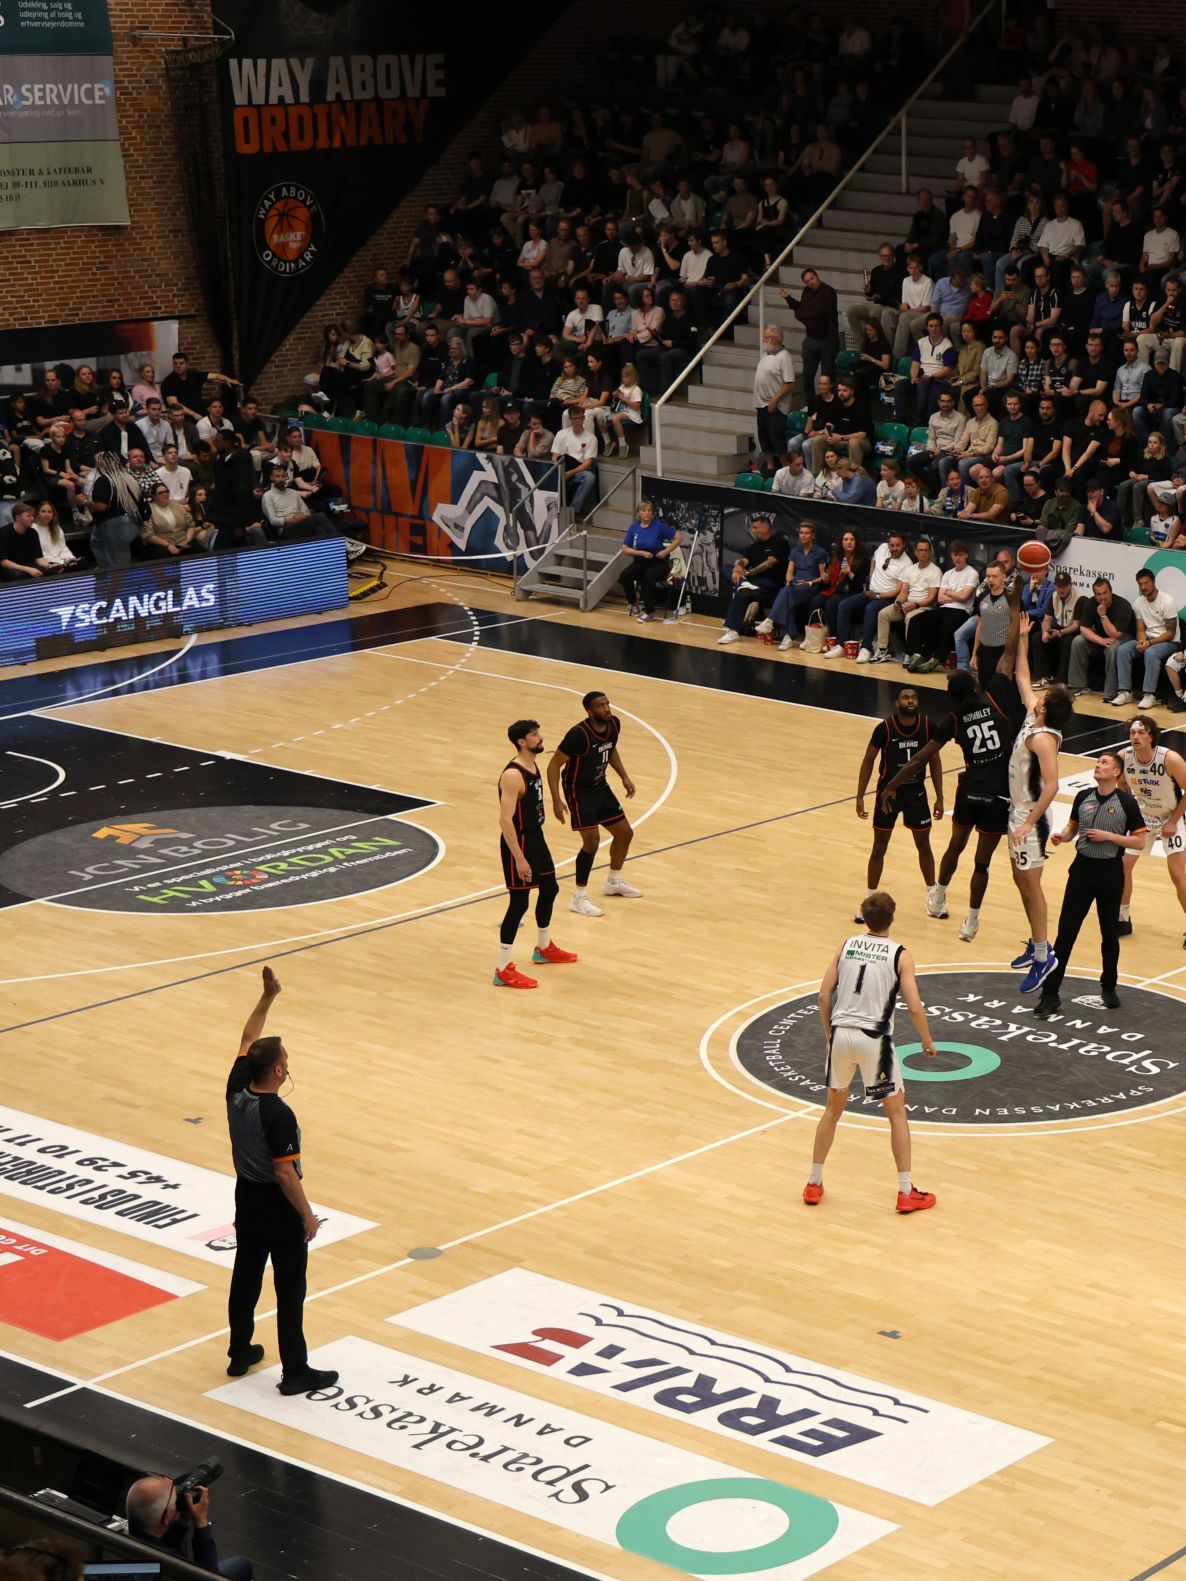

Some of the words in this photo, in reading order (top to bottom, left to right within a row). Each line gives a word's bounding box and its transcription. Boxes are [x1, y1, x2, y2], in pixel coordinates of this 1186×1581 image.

[20, 11, 48, 20] udlejning
[229, 58, 315, 105] WAY
[326, 54, 446, 101] ABOVE
[21, 83, 106, 106] SERVICE
[233, 98, 431, 154] ORDINARY
[258, 191, 276, 219] WAY
[263, 243, 318, 272] ORDINARY
[1049, 560, 1115, 581] Sparekassen
[75, 584, 216, 628] SCANGLAS
[966, 720, 1001, 754] 25
[1137, 778, 1160, 787] STARK
[1150, 762, 1165, 777] 40
[157, 819, 311, 858] BOLIG
[1167, 835, 1182, 849] 40
[67, 854, 166, 881] JCN
[136, 836, 403, 905] HVORDAN
[1014, 851, 1028, 866] 35
[849, 939, 890, 954] INVITA
[854, 950, 889, 962] MISTER
[853, 963, 867, 996] 1
[768, 1004, 821, 1037] CENTER
[894, 995, 1180, 1076] Sparekass
[763, 1039, 827, 1092] BASKETBALL
[974, 1085, 1154, 1116] SPAREKASSEN
[2, 1133, 45, 1147] 11
[36, 1144, 82, 1159] 10
[75, 1156, 128, 1172] 29
[115, 1169, 182, 1190] +45
[79, 1188, 142, 1211] OS
[115, 1200, 200, 1230] FIND
[14, 1243, 48, 1256] DIT
[388, 1373, 593, 1448] DANMARK
[566, 1343, 885, 1458] ERRIA
[305, 1385, 616, 1505] Sparekasse
